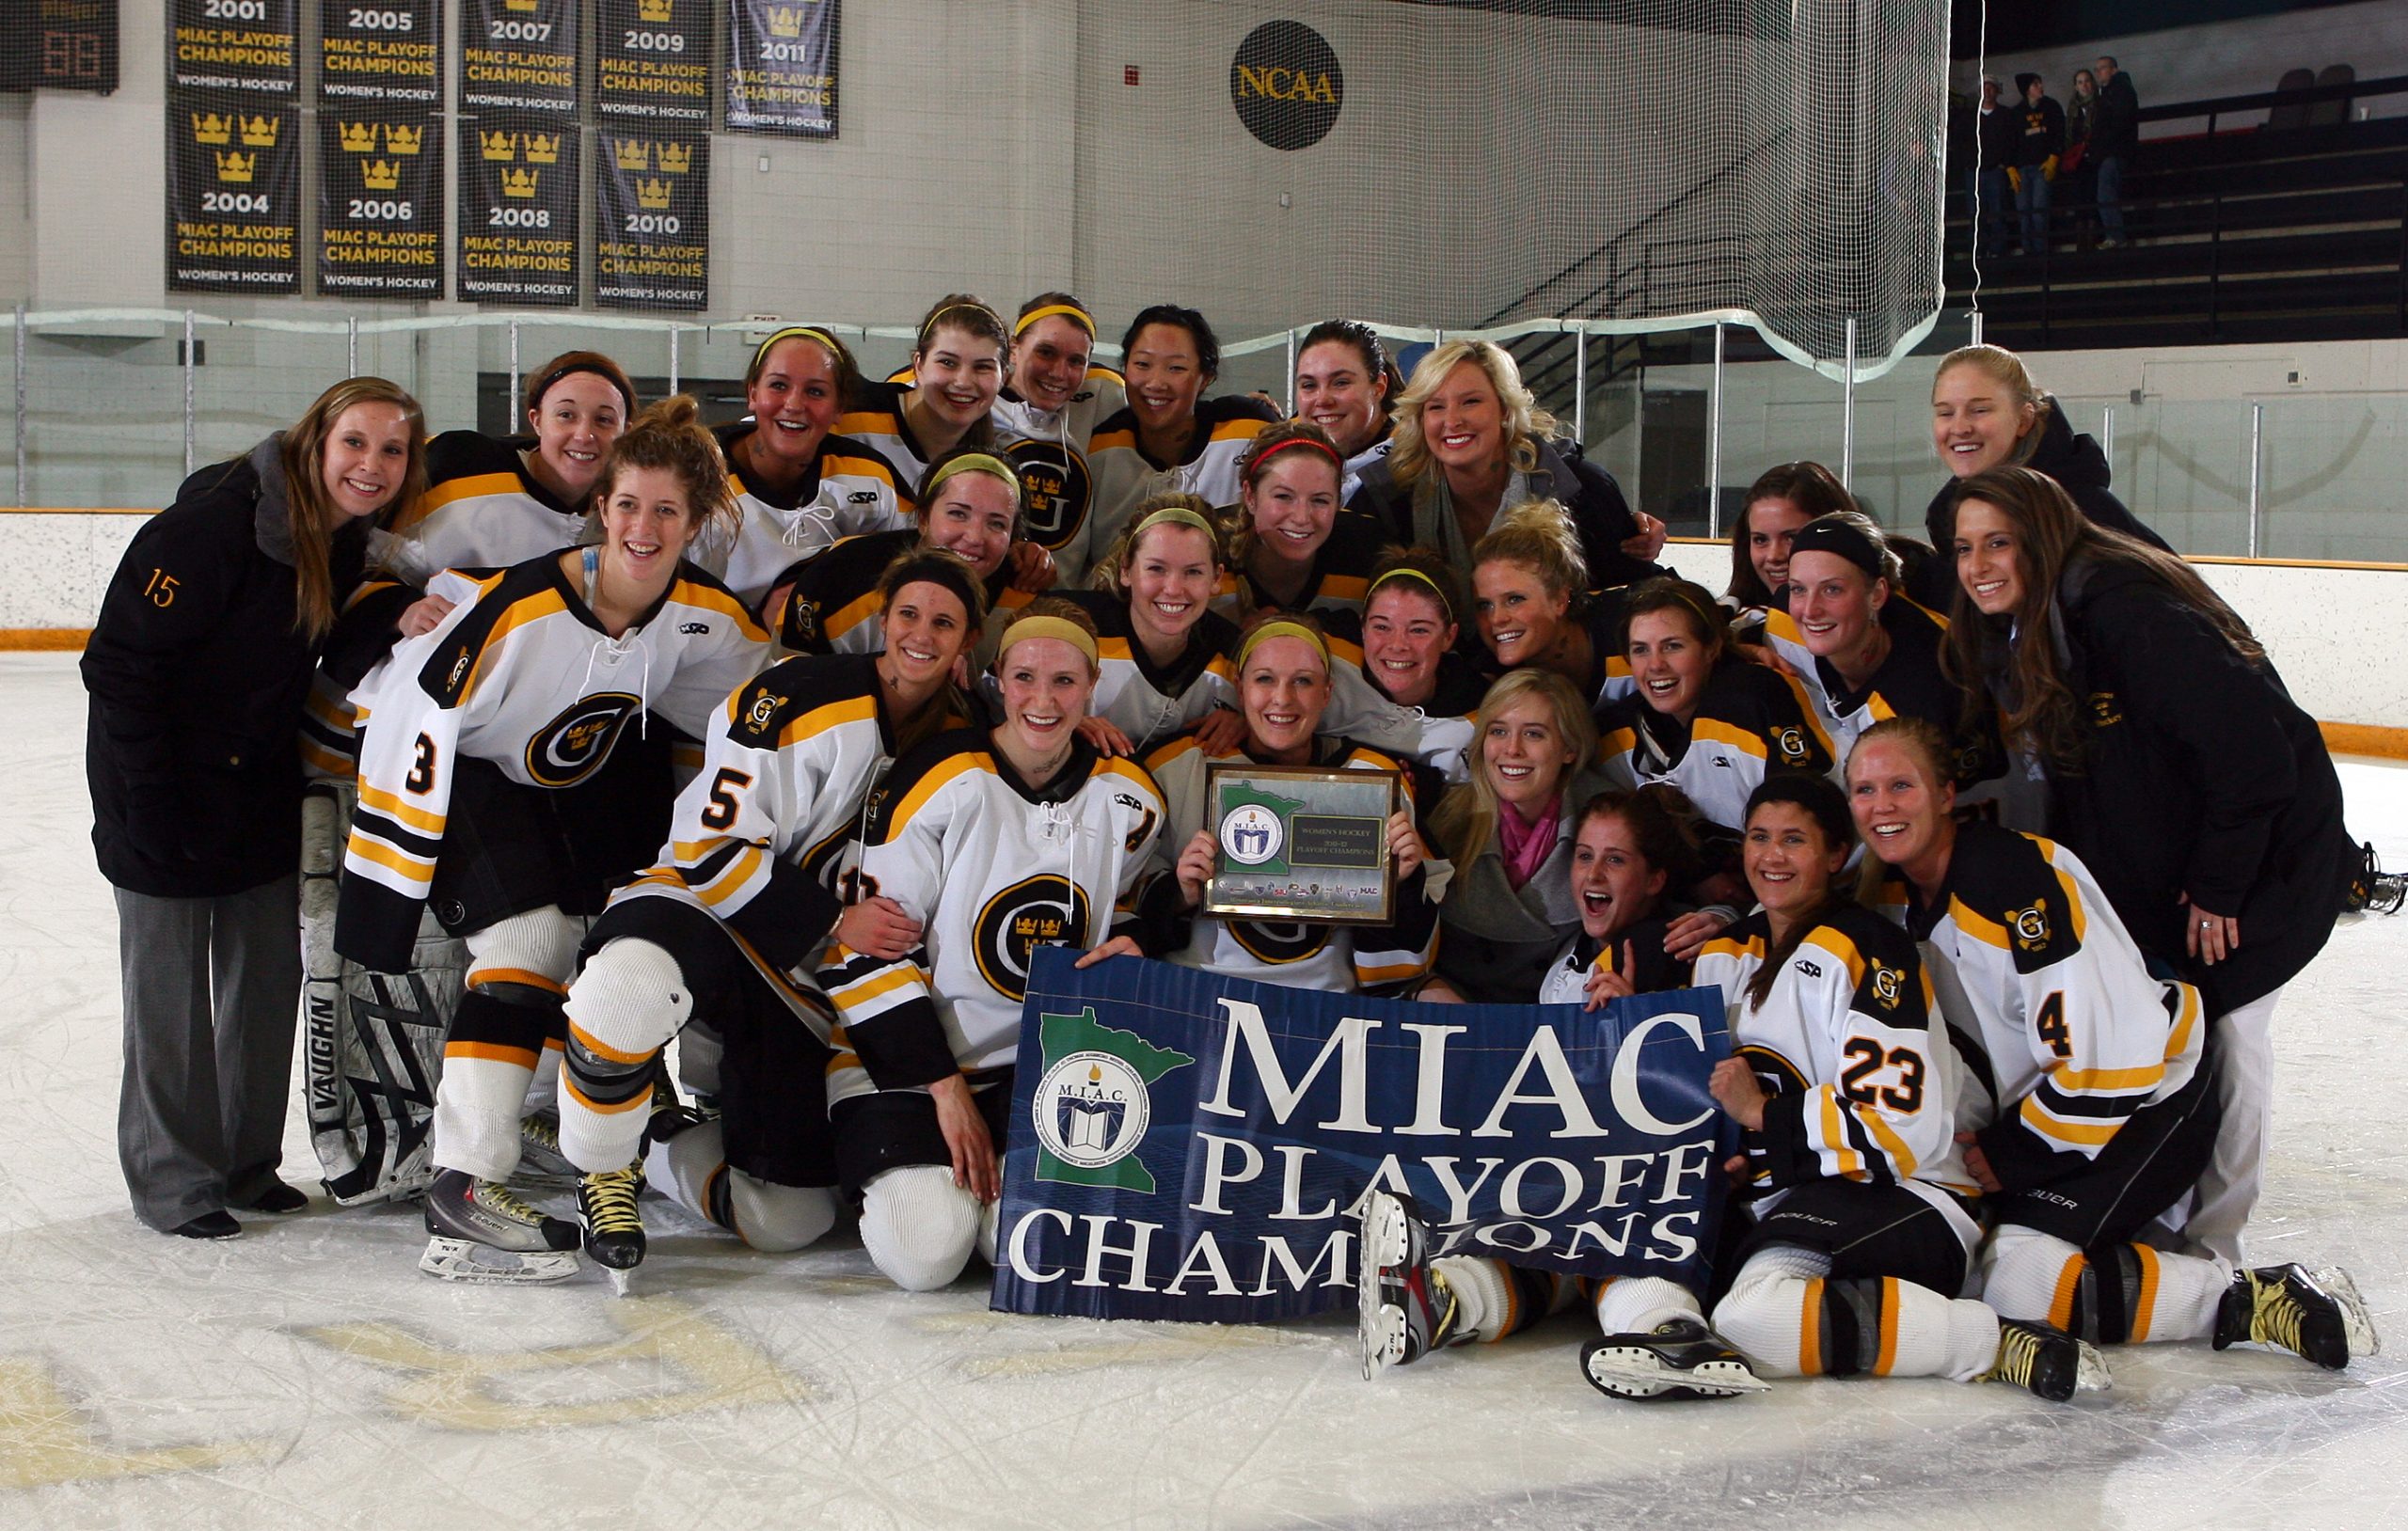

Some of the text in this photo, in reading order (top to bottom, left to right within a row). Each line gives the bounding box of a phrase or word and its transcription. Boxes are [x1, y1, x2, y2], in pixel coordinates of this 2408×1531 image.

[205, 0, 265, 20] 2001
[348, 8, 413, 31] 2005
[176, 28, 293, 47] MIAC PLAYOFF
[491, 21, 551, 41] 2007
[624, 30, 685, 52] 2009
[179, 45, 293, 67] CHAMPIONS
[324, 39, 437, 58] MIAC PLAYOFF
[760, 42, 806, 62] 2011
[325, 55, 436, 76] CHAMPIONS
[466, 49, 575, 69] MIAC PLAYOFF
[600, 58, 707, 77] MIAC PLAYOFF
[178, 74, 293, 91] WOMEN'S HOCKEY
[467, 66, 573, 87] CHAMPIONS
[602, 74, 705, 96] CHAMPIONS
[731, 70, 833, 88] MIAC PLAYOFF
[1238, 65, 1338, 103] NCAA
[325, 84, 437, 101] WOMEN'S HOCKEY
[466, 93, 575, 111] WOMEN'S HOCKEY
[734, 85, 832, 105] CHAMPIONS
[600, 103, 706, 119] WOMEN'S HOCKEY
[731, 112, 832, 129] WOMEN'S HOCKEY
[201, 193, 269, 213] 2004
[348, 199, 412, 220] 2006
[489, 207, 550, 228] 2008
[625, 214, 680, 234] 2010
[177, 223, 293, 241] MIAC PLAYOFF
[324, 229, 437, 246] MIAC PLAYOFF
[179, 240, 293, 259] CHAMPIONS
[325, 246, 436, 265] CHAMPIONS
[464, 237, 573, 254] MIAC PLAYOFF
[599, 243, 705, 260] MIAC PLAYOFF
[466, 252, 571, 272] CHAMPIONS
[601, 259, 704, 277] CHAMPIONS
[178, 269, 293, 283] WOMEN'S HOCKEY
[325, 275, 437, 289] WOMEN'S HOCKEY
[465, 281, 573, 295] WOMEN'S HOCKEY
[599, 287, 704, 301] WOMEN'S HOCKEY
[143, 567, 182, 608] 15
[405, 731, 438, 797] 3
[700, 766, 754, 833] 5
[2036, 989, 2075, 1059] 4
[311, 995, 338, 1110] VAUGHN
[1198, 997, 1716, 1139] MIAC
[1841, 1035, 1925, 1116] 23
[1058, 1084, 1128, 1102] M.I.A.C.
[1007, 1207, 1701, 1297] CHAMIONS
